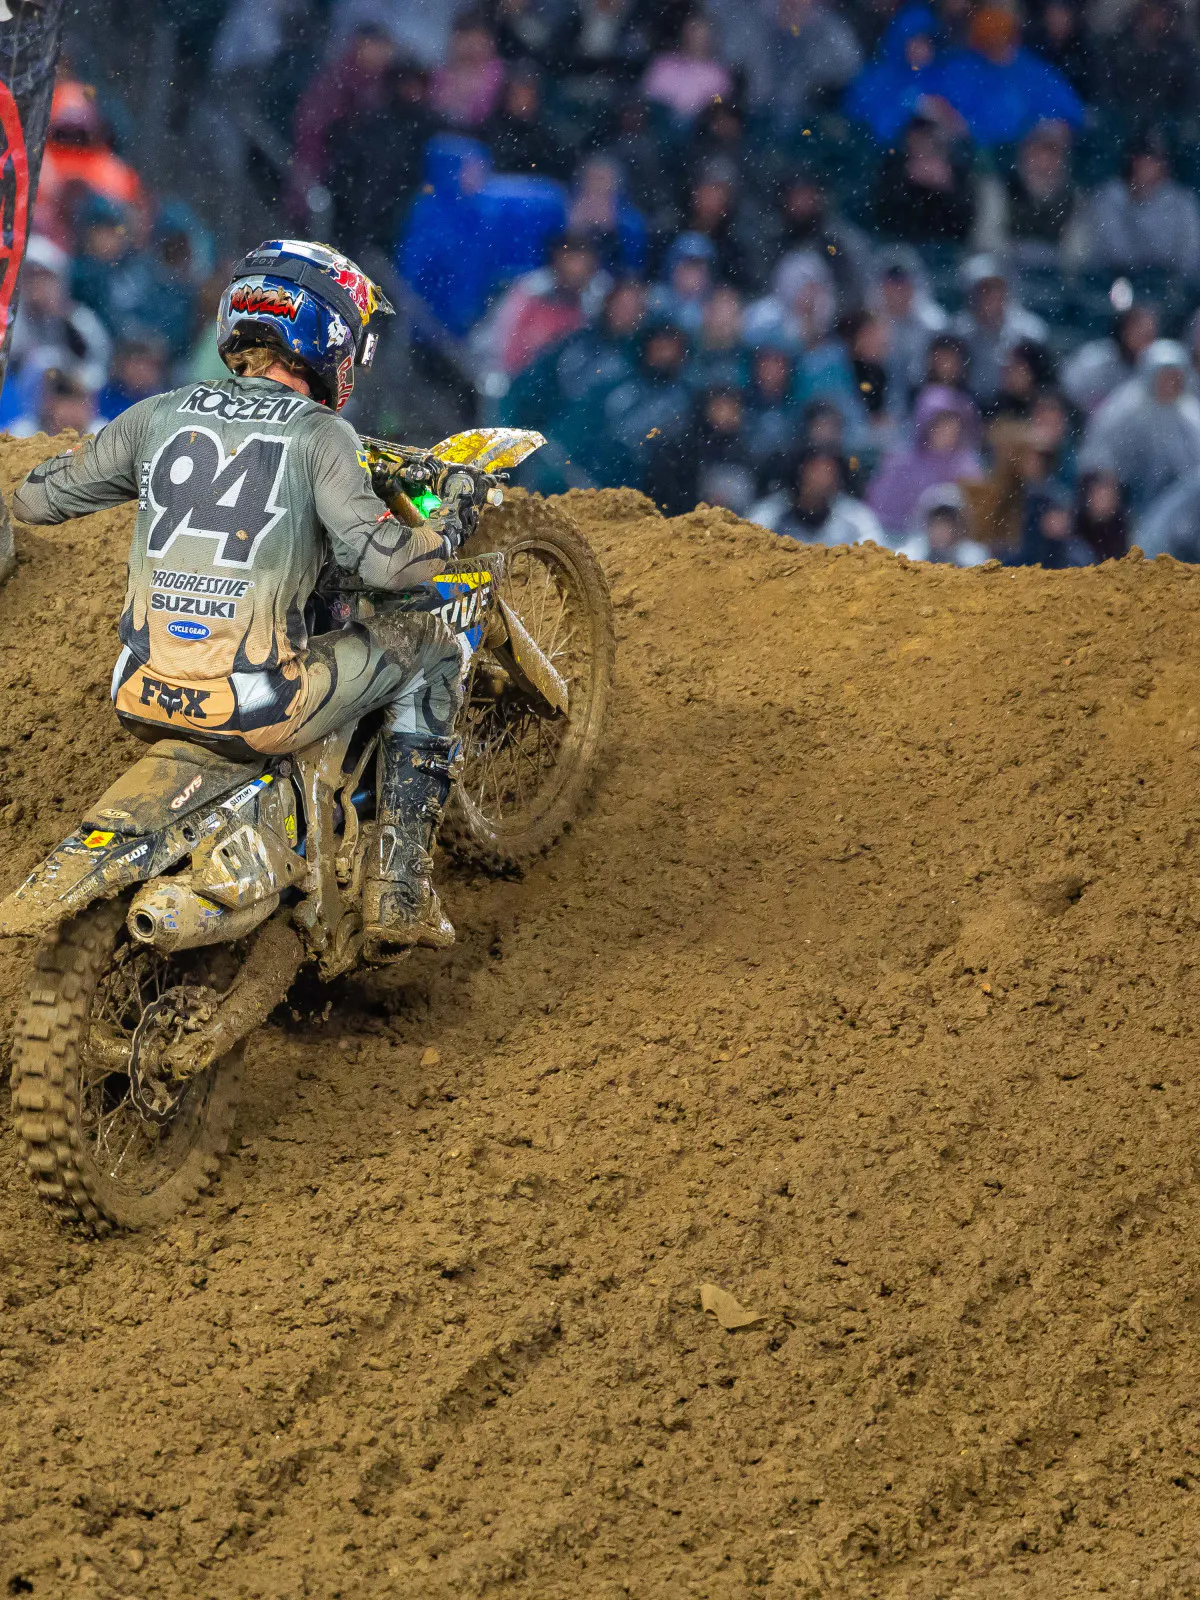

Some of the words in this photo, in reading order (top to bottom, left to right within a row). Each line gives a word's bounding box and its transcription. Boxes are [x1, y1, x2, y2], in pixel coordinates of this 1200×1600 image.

[252, 258, 275, 267] FOX
[179, 386, 306, 424] ROCZEN
[147, 426, 291, 569] 94
[151, 570, 249, 598] PROGRESSIVE
[151, 593, 236, 619] SUZUKI
[169, 624, 189, 634] CYCLE
[189, 627, 207, 636] GEAR
[170, 775, 202, 809] GUTS
[229, 787, 253, 807] SUZUKI
